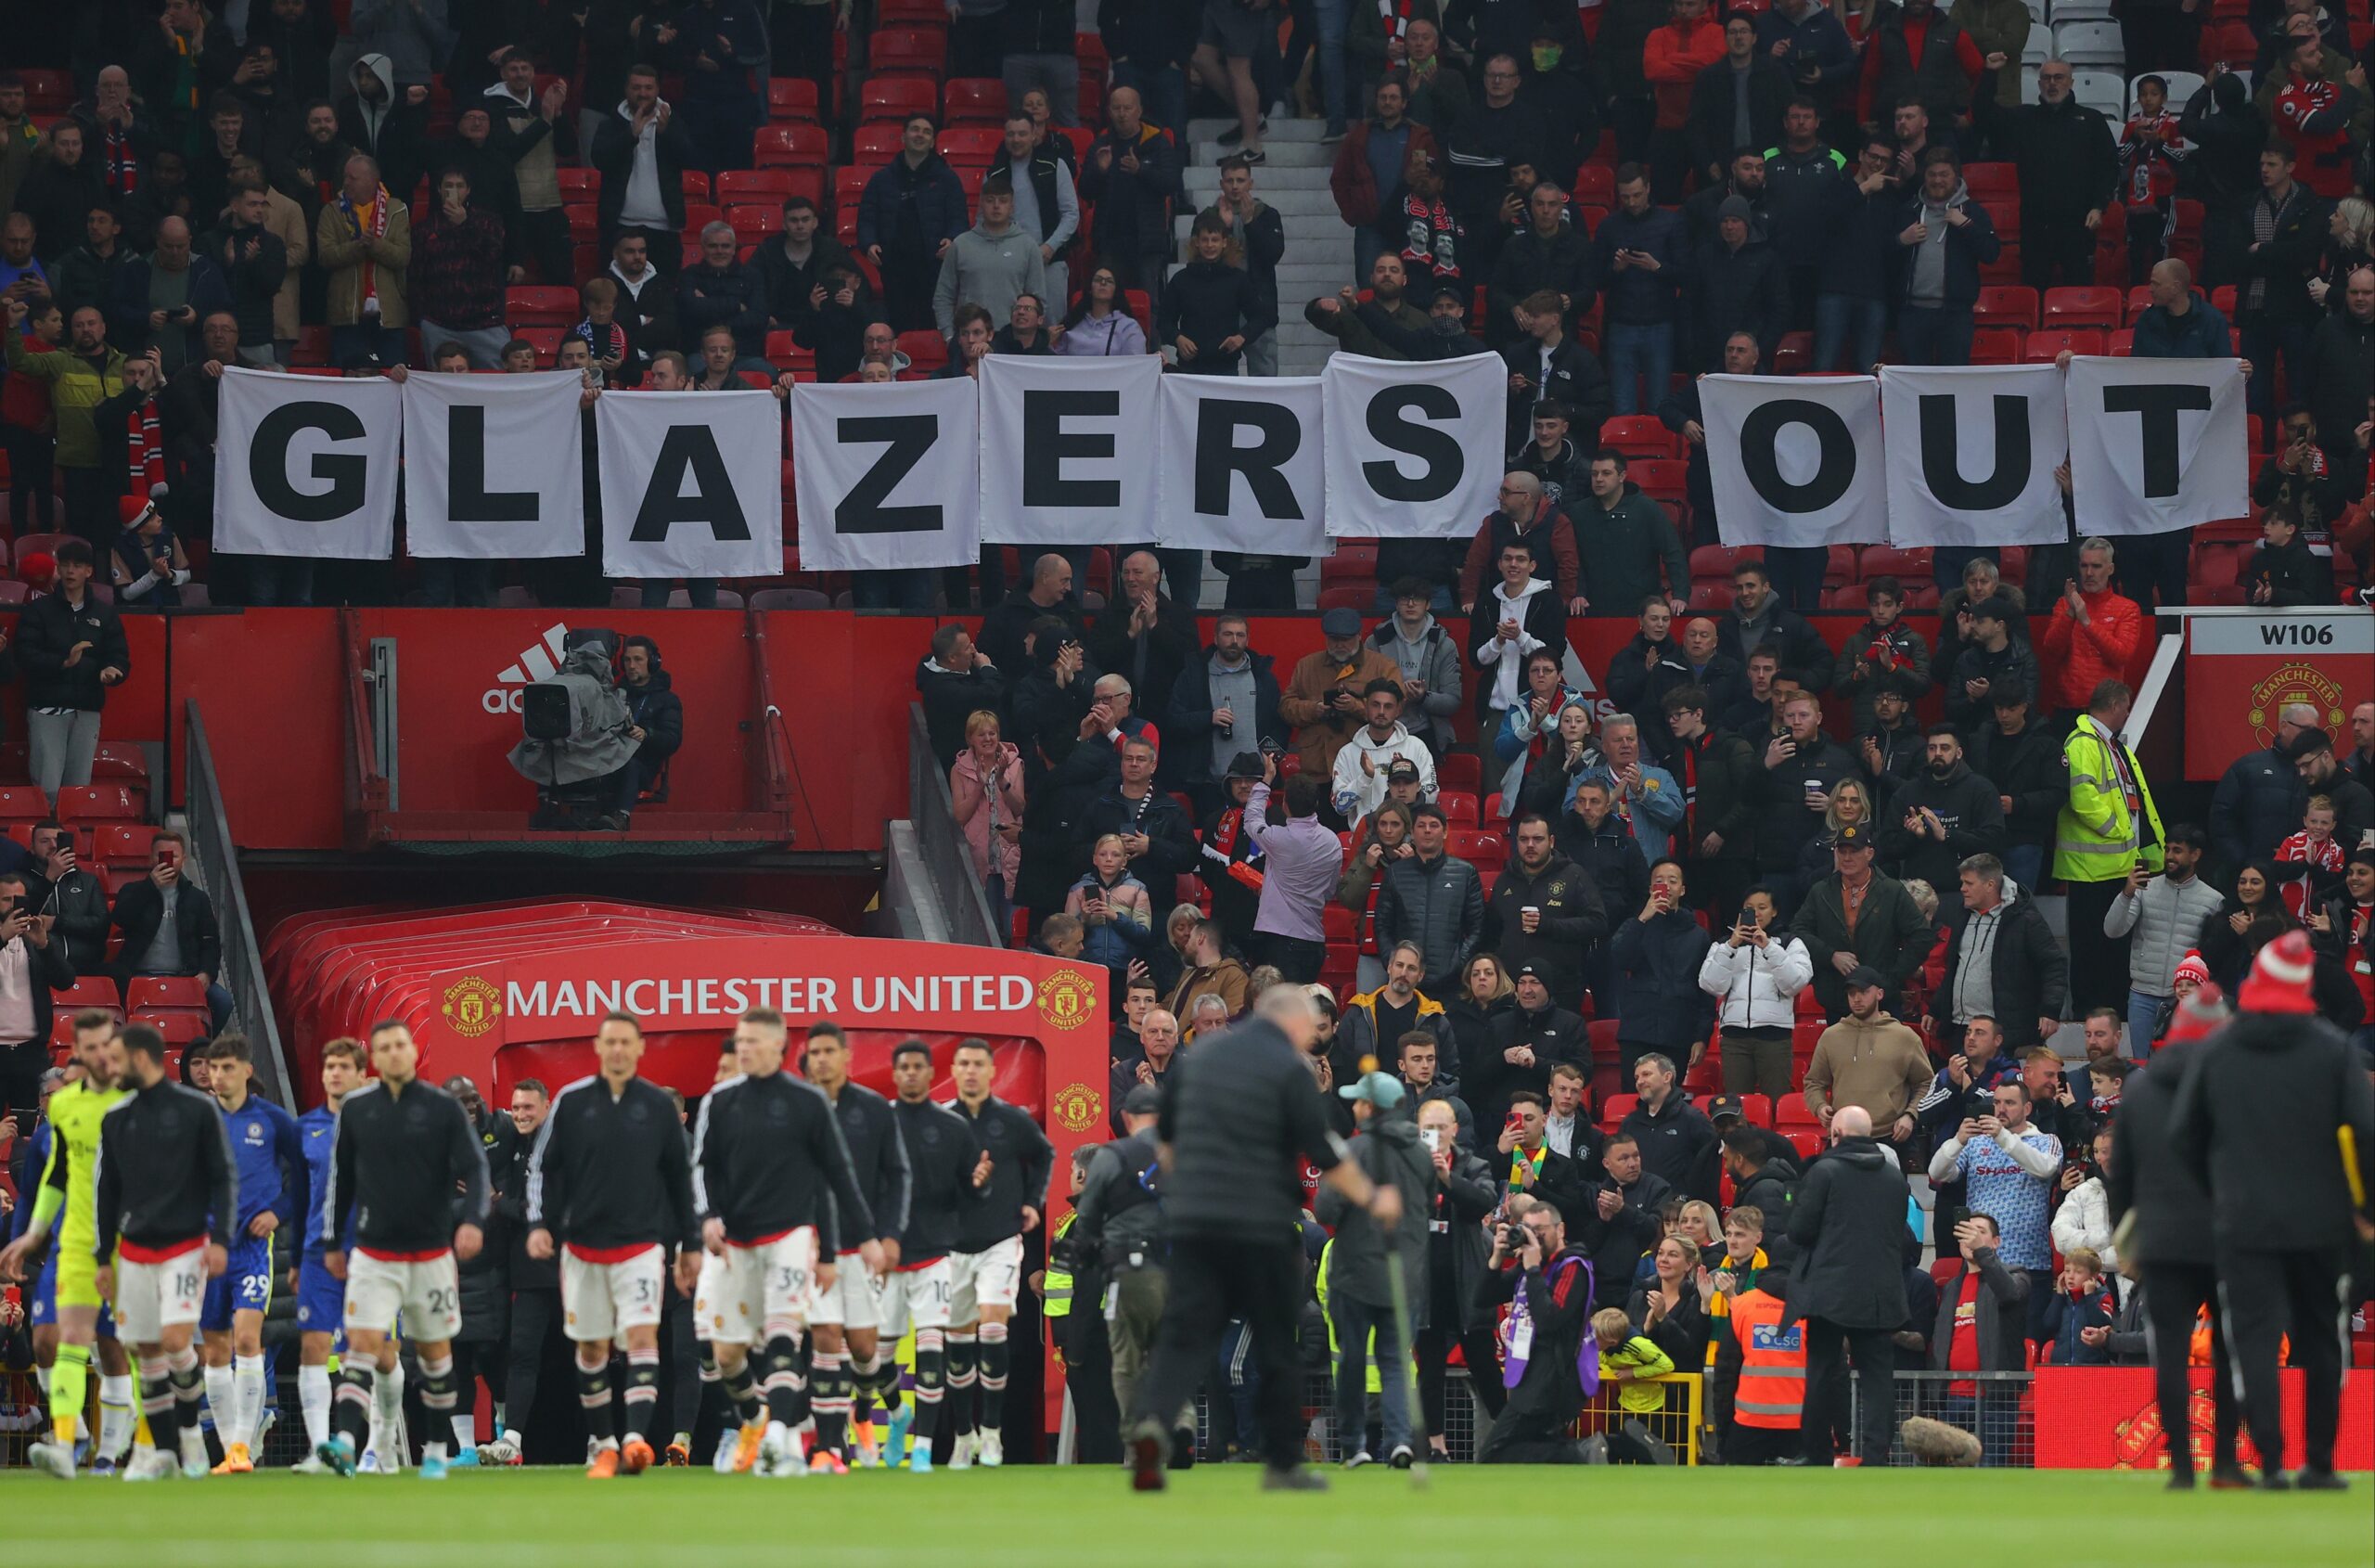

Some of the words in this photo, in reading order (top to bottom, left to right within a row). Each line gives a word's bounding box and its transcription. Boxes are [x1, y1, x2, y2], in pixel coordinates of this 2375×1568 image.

[250, 384, 1464, 542] GLAZERS
[1740, 384, 2212, 513] OUT
[2261, 624, 2333, 645] W106
[2259, 670, 2335, 702] MANCHESTER
[448, 981, 496, 1000] MANCHESTER
[1043, 973, 1091, 994] MANCHESTER
[506, 978, 837, 1017] MANCHESTER
[852, 975, 1034, 1013] UNITED
[456, 1022, 489, 1034] UNITED
[1050, 1015, 1084, 1026] UNITED
[1058, 1085, 1098, 1102] MANCHESTER
[1064, 1118, 1092, 1129] UNITED
[175, 1272, 198, 1298] 18
[242, 1274, 269, 1298] 29
[776, 1266, 806, 1292] 39
[1007, 1265, 1017, 1285] 7
[428, 1286, 457, 1314] 20
[635, 1278, 659, 1301] 31
[933, 1279, 952, 1303] 10
[1774, 1336, 1800, 1347] CSG
